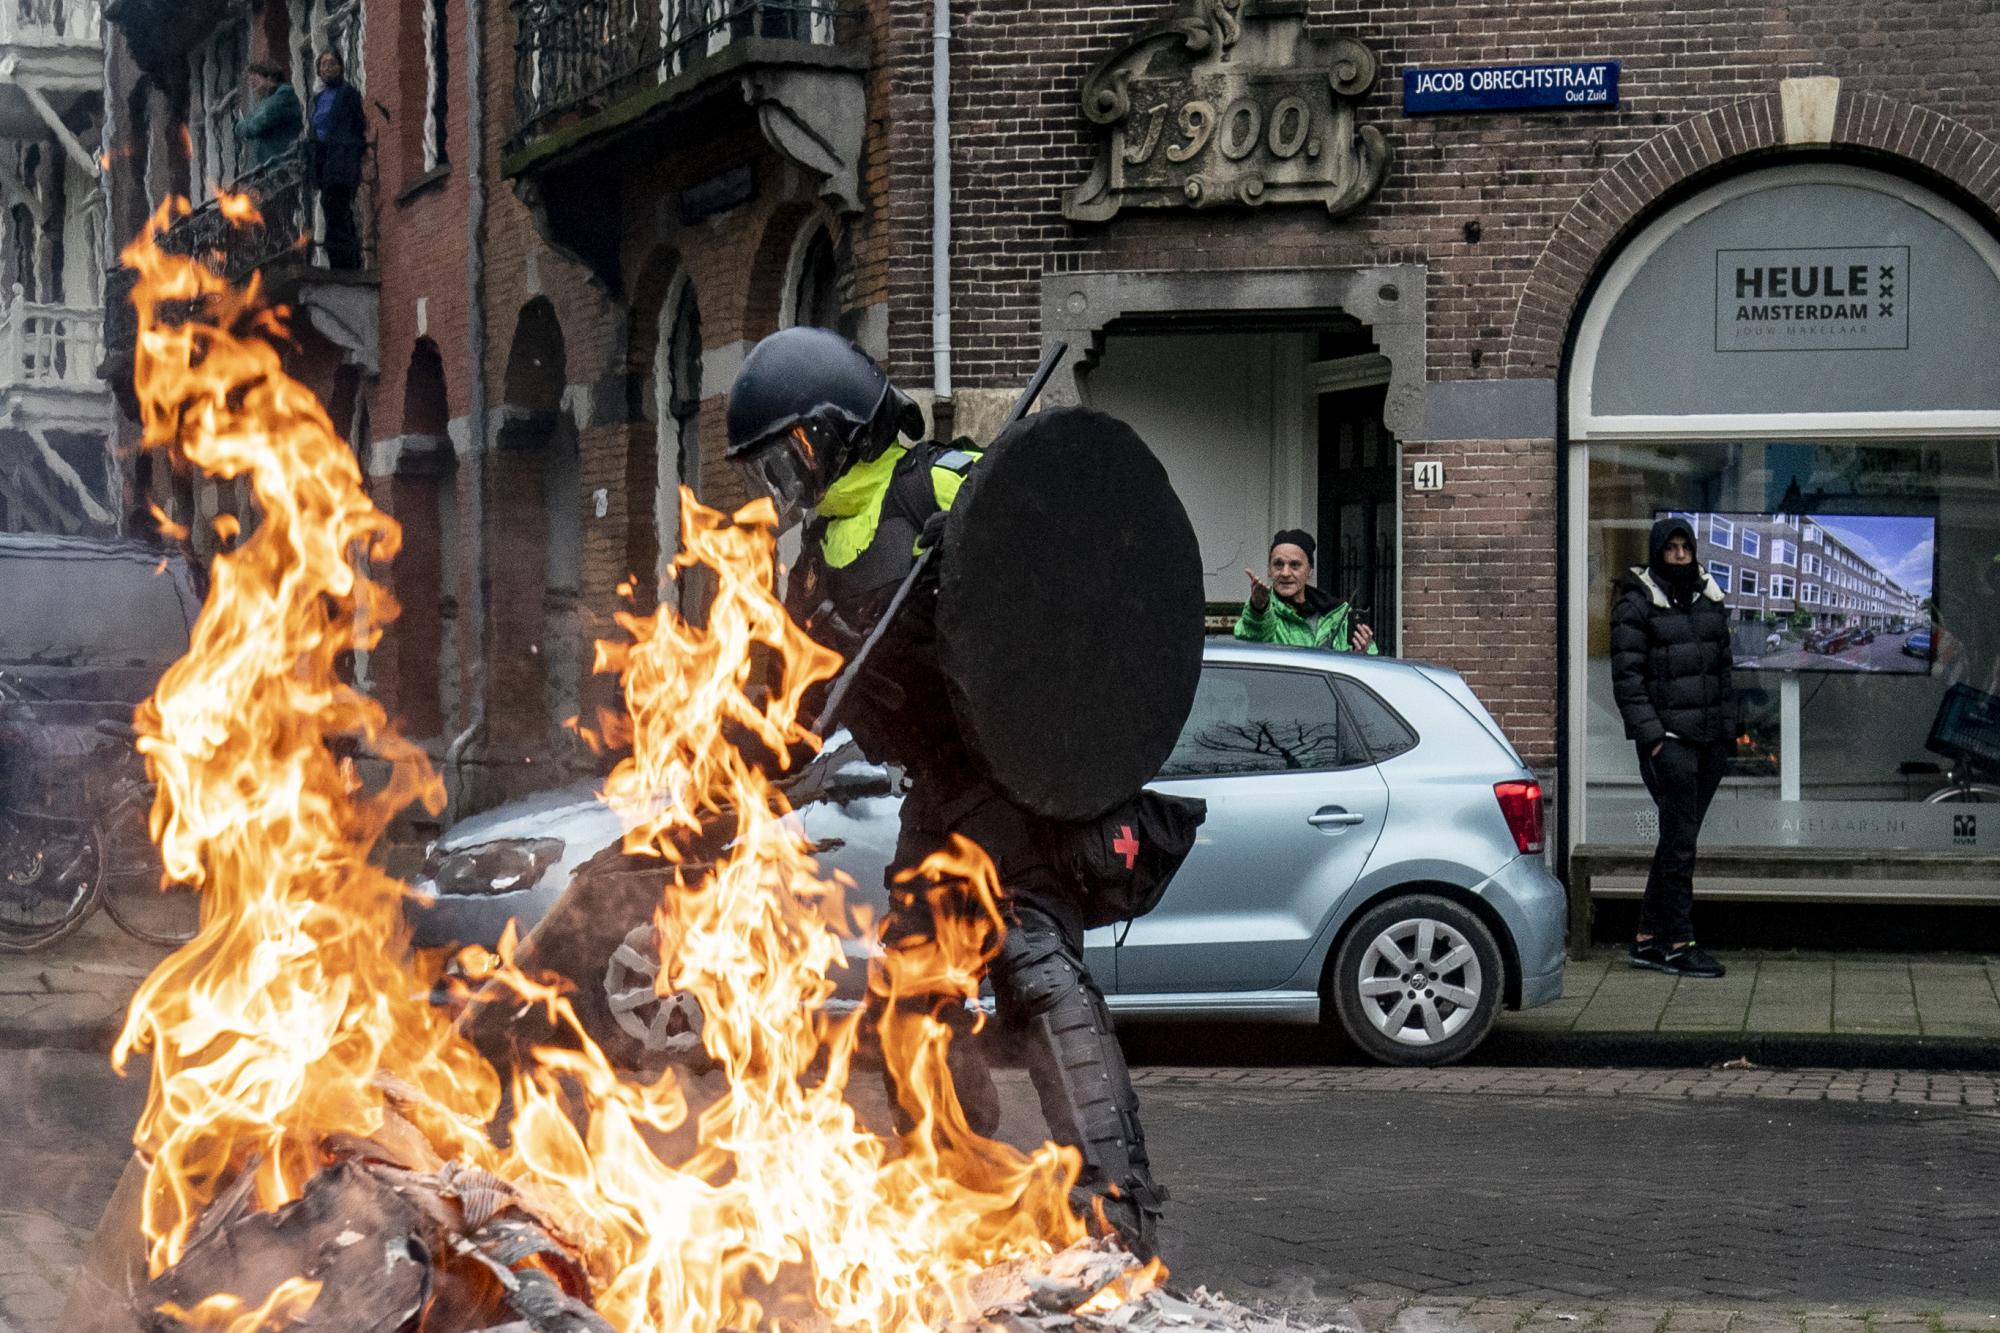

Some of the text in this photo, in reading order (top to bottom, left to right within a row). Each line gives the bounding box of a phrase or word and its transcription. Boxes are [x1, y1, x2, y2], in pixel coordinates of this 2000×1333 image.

[1416, 66, 1607, 94] JACOB OBRECHTSTRAAT
[1565, 89, 1607, 102] Oud Zuid
[1736, 265, 1868, 298] HEULE
[1736, 303, 1868, 321] AMSTERDAM
[1736, 325, 1868, 337] JOUW MAKELAAR
[1418, 464, 1438, 488] 41
